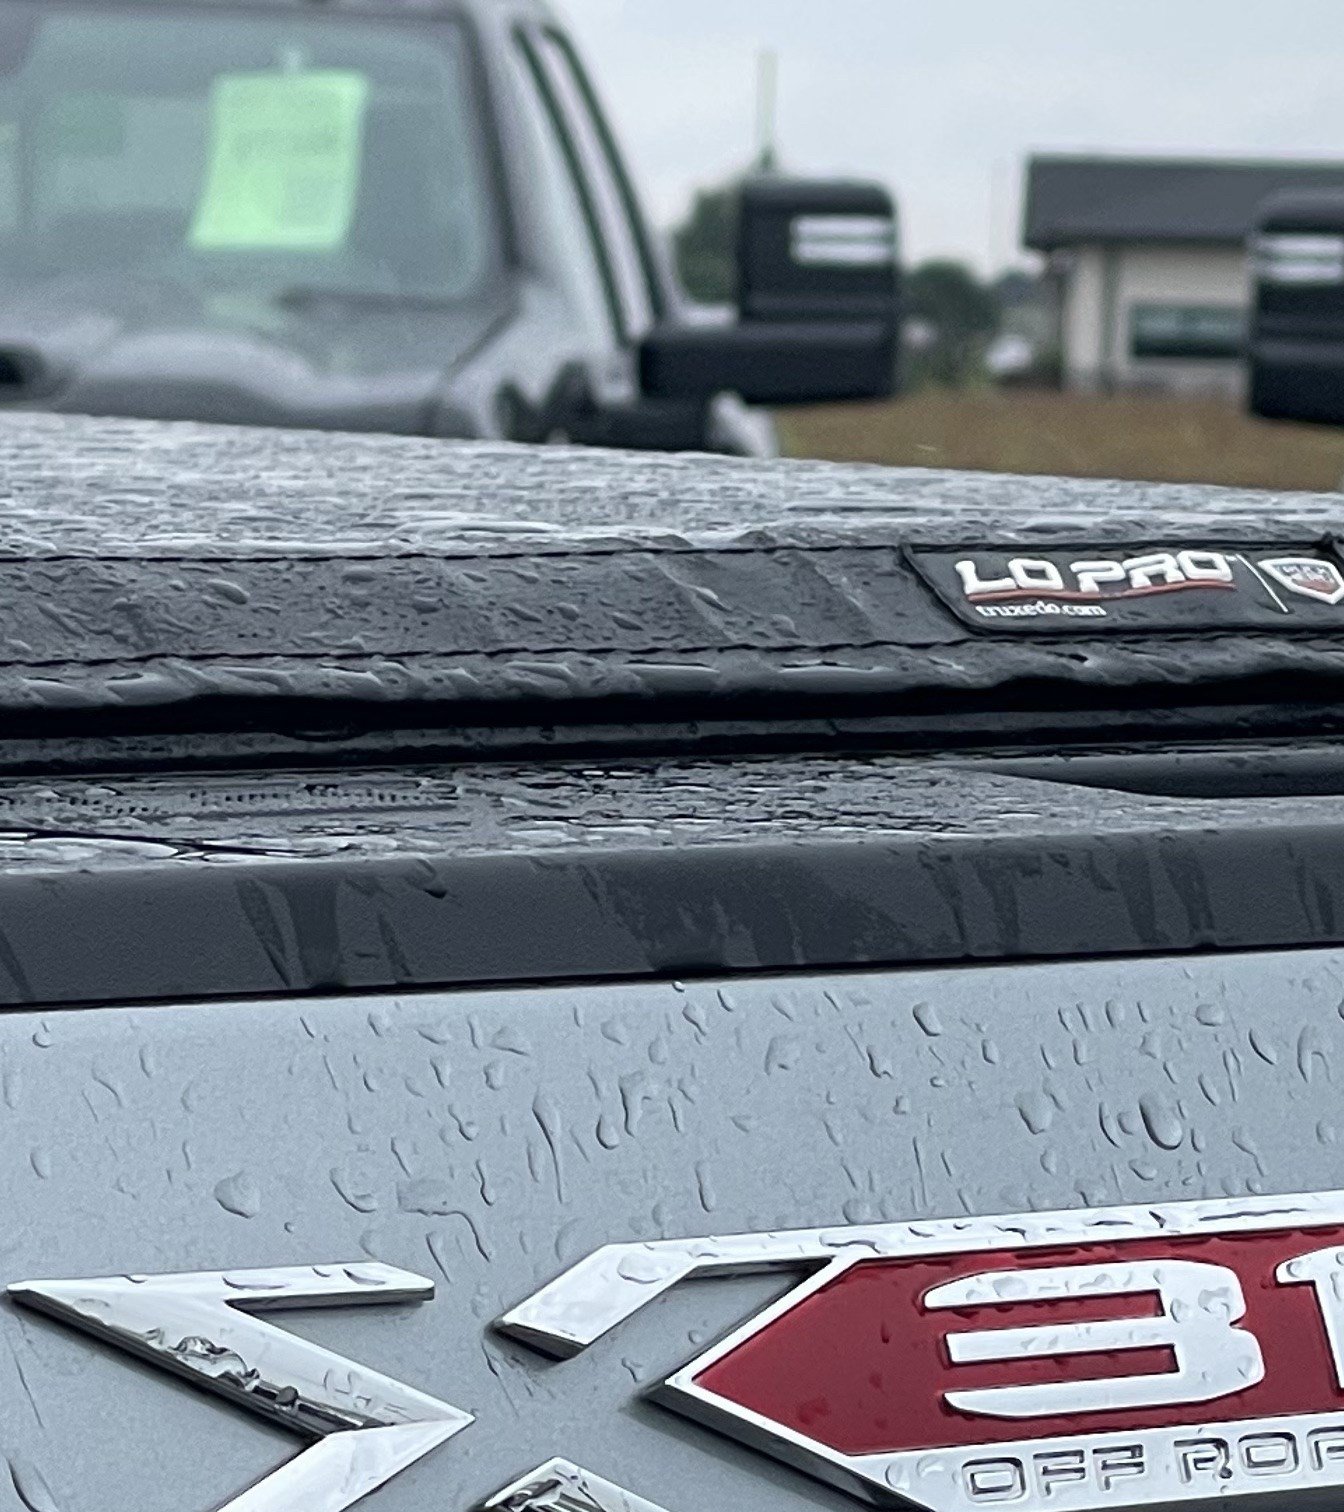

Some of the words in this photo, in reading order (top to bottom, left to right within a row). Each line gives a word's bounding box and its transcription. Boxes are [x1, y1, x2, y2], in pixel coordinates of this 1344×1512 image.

[955, 557, 1064, 595] LO
[1069, 550, 1232, 593] PRO
[975, 601, 1107, 618] truxedo.com
[960, 1444, 1145, 1504] OFF
